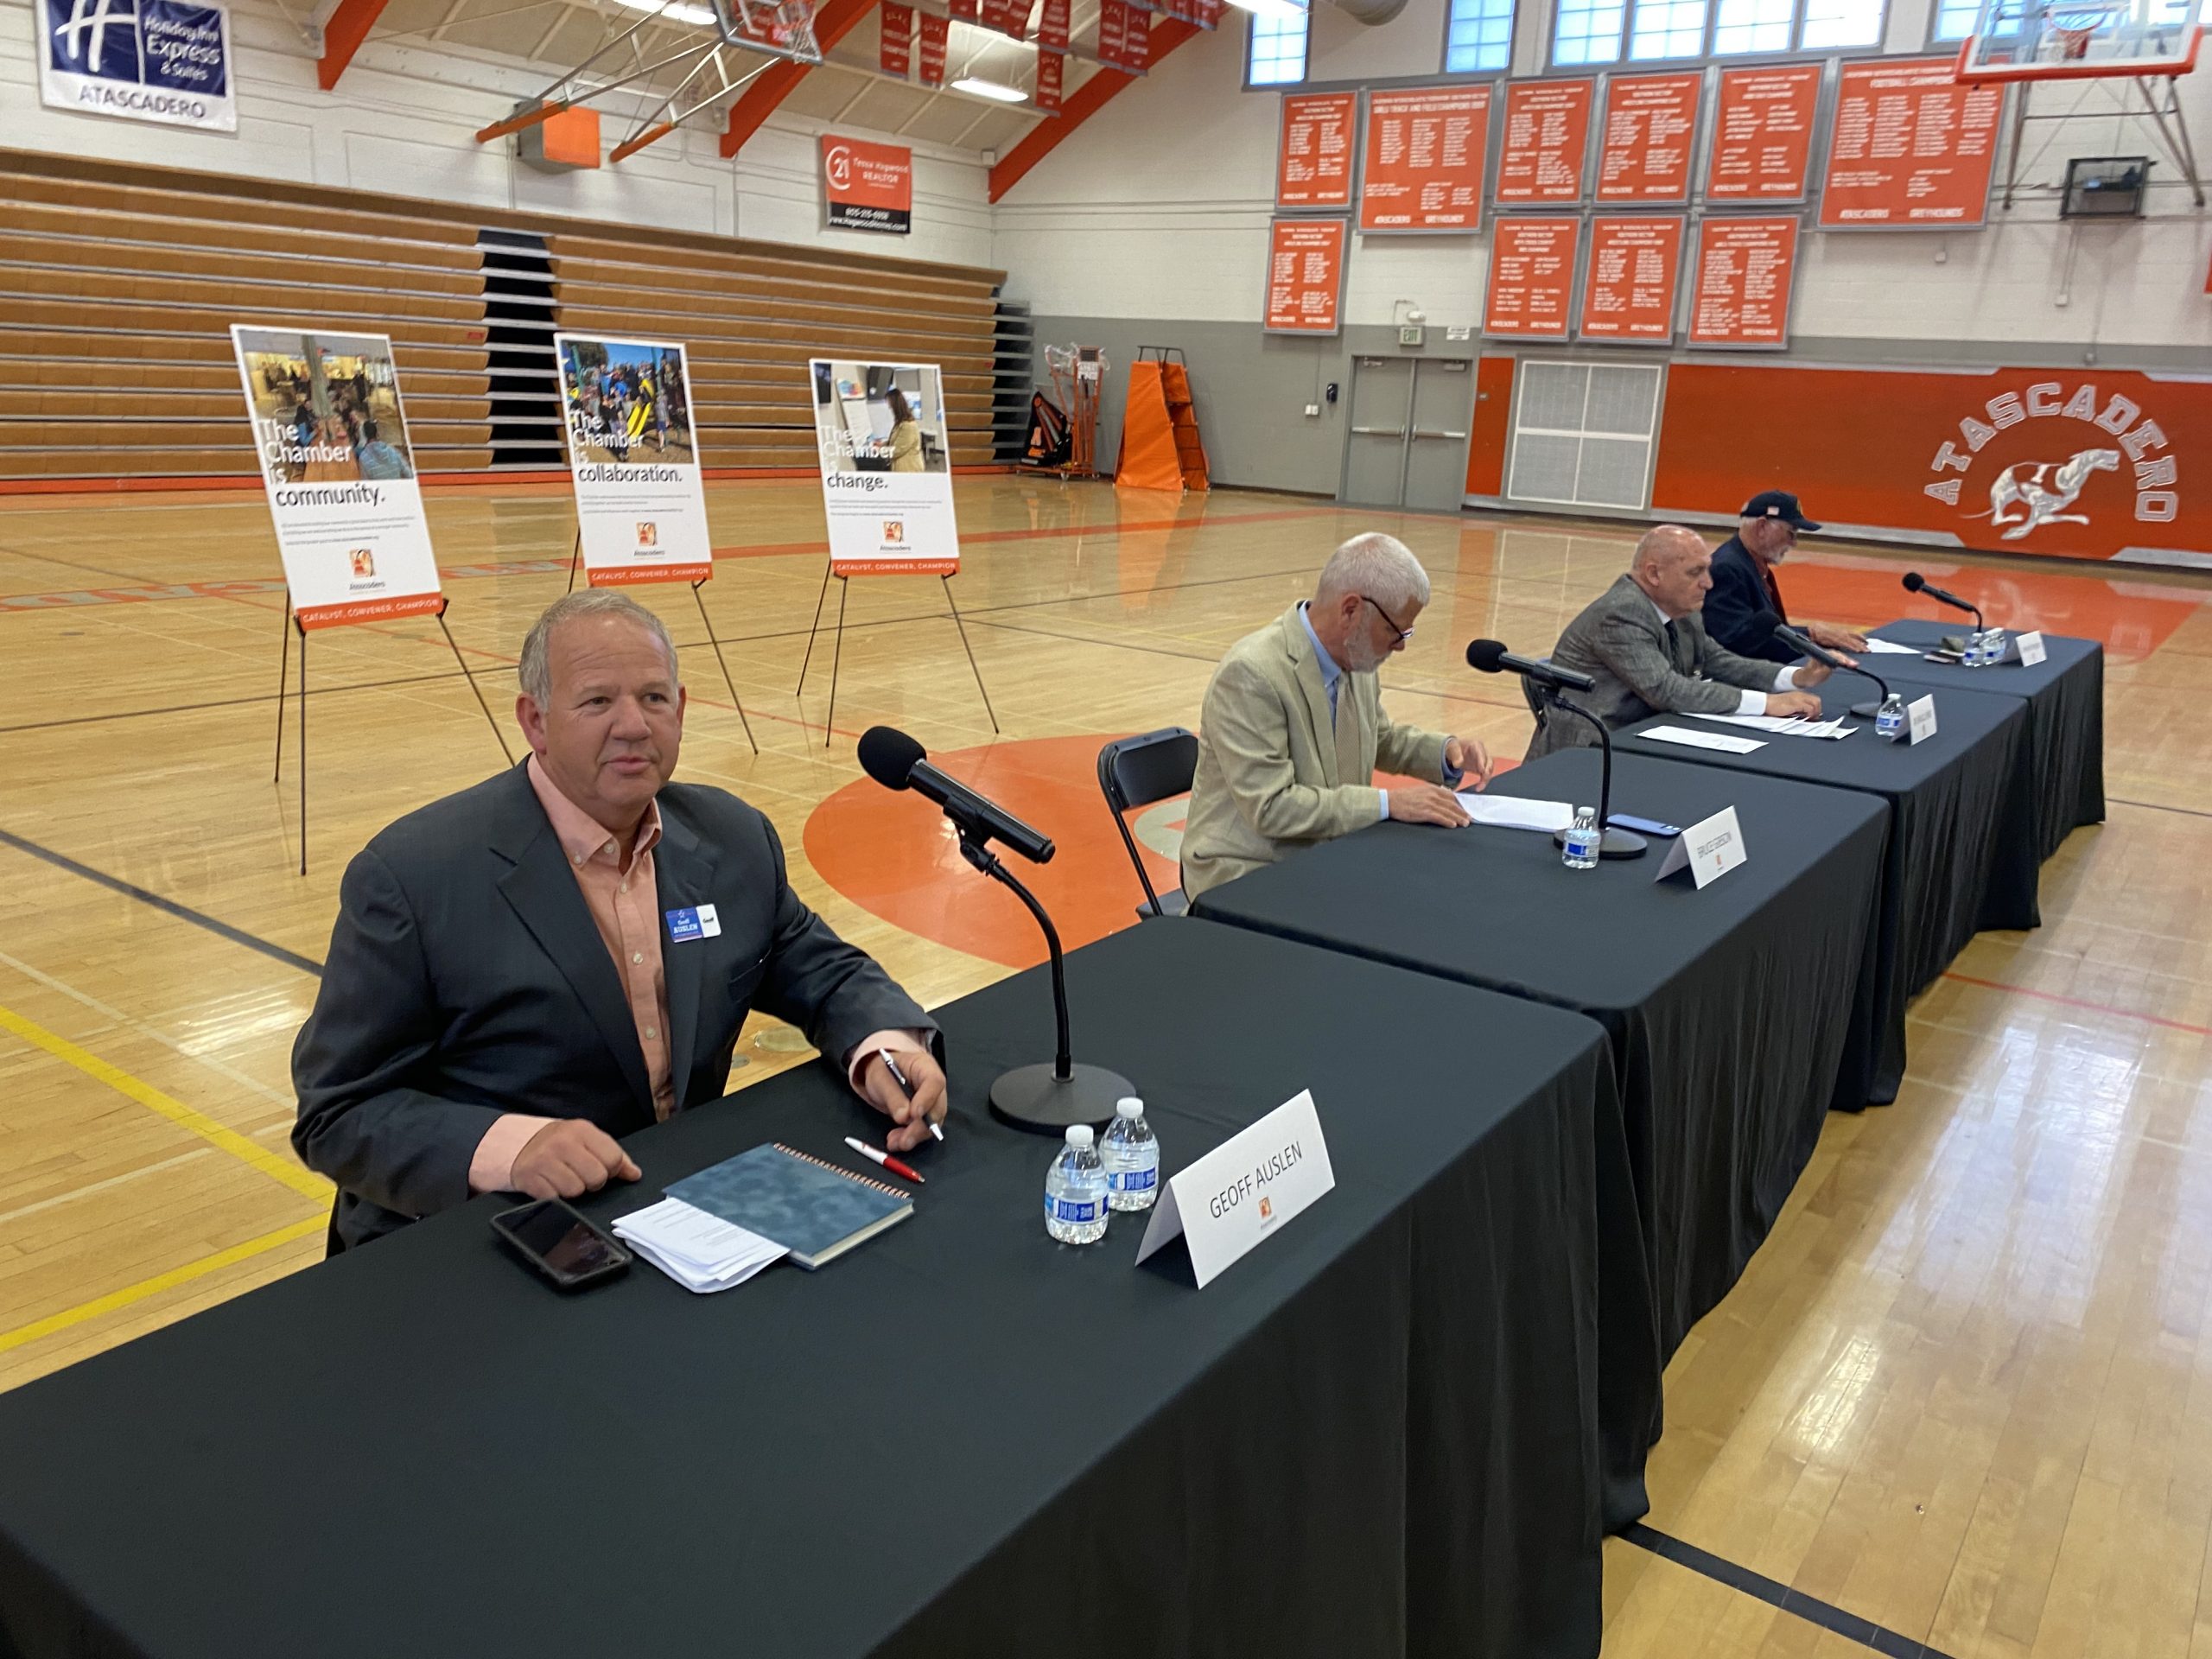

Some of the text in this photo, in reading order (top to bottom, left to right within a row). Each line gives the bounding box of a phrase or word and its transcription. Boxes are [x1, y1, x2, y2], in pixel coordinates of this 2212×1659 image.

[144, 14, 219, 42] Holiday Inn
[147, 34, 222, 66] Express
[160, 60, 209, 81] & Suites
[79, 85, 207, 119] ATASCADERO
[862, 171, 899, 184] REALTOR
[1403, 328, 1419, 342] EXIT
[258, 417, 300, 442] The
[569, 408, 604, 430] The
[572, 428, 646, 448] Chamber
[820, 425, 854, 443] The
[265, 440, 353, 464] Chamber
[574, 446, 589, 465] is
[823, 440, 897, 459] Chamber
[1923, 382, 2179, 523] ATASCADERO
[269, 463, 288, 485] is
[578, 465, 683, 483] collaboration.
[827, 471, 889, 493] change.
[276, 481, 386, 507] community.
[671, 567, 709, 576] CHAMPION
[395, 599, 440, 612] CHAMPION
[674, 922, 698, 934] AUSLEN
[1210, 1174, 1253, 1218] GEOFF
[1255, 1141, 1302, 1189] AUSLEN
